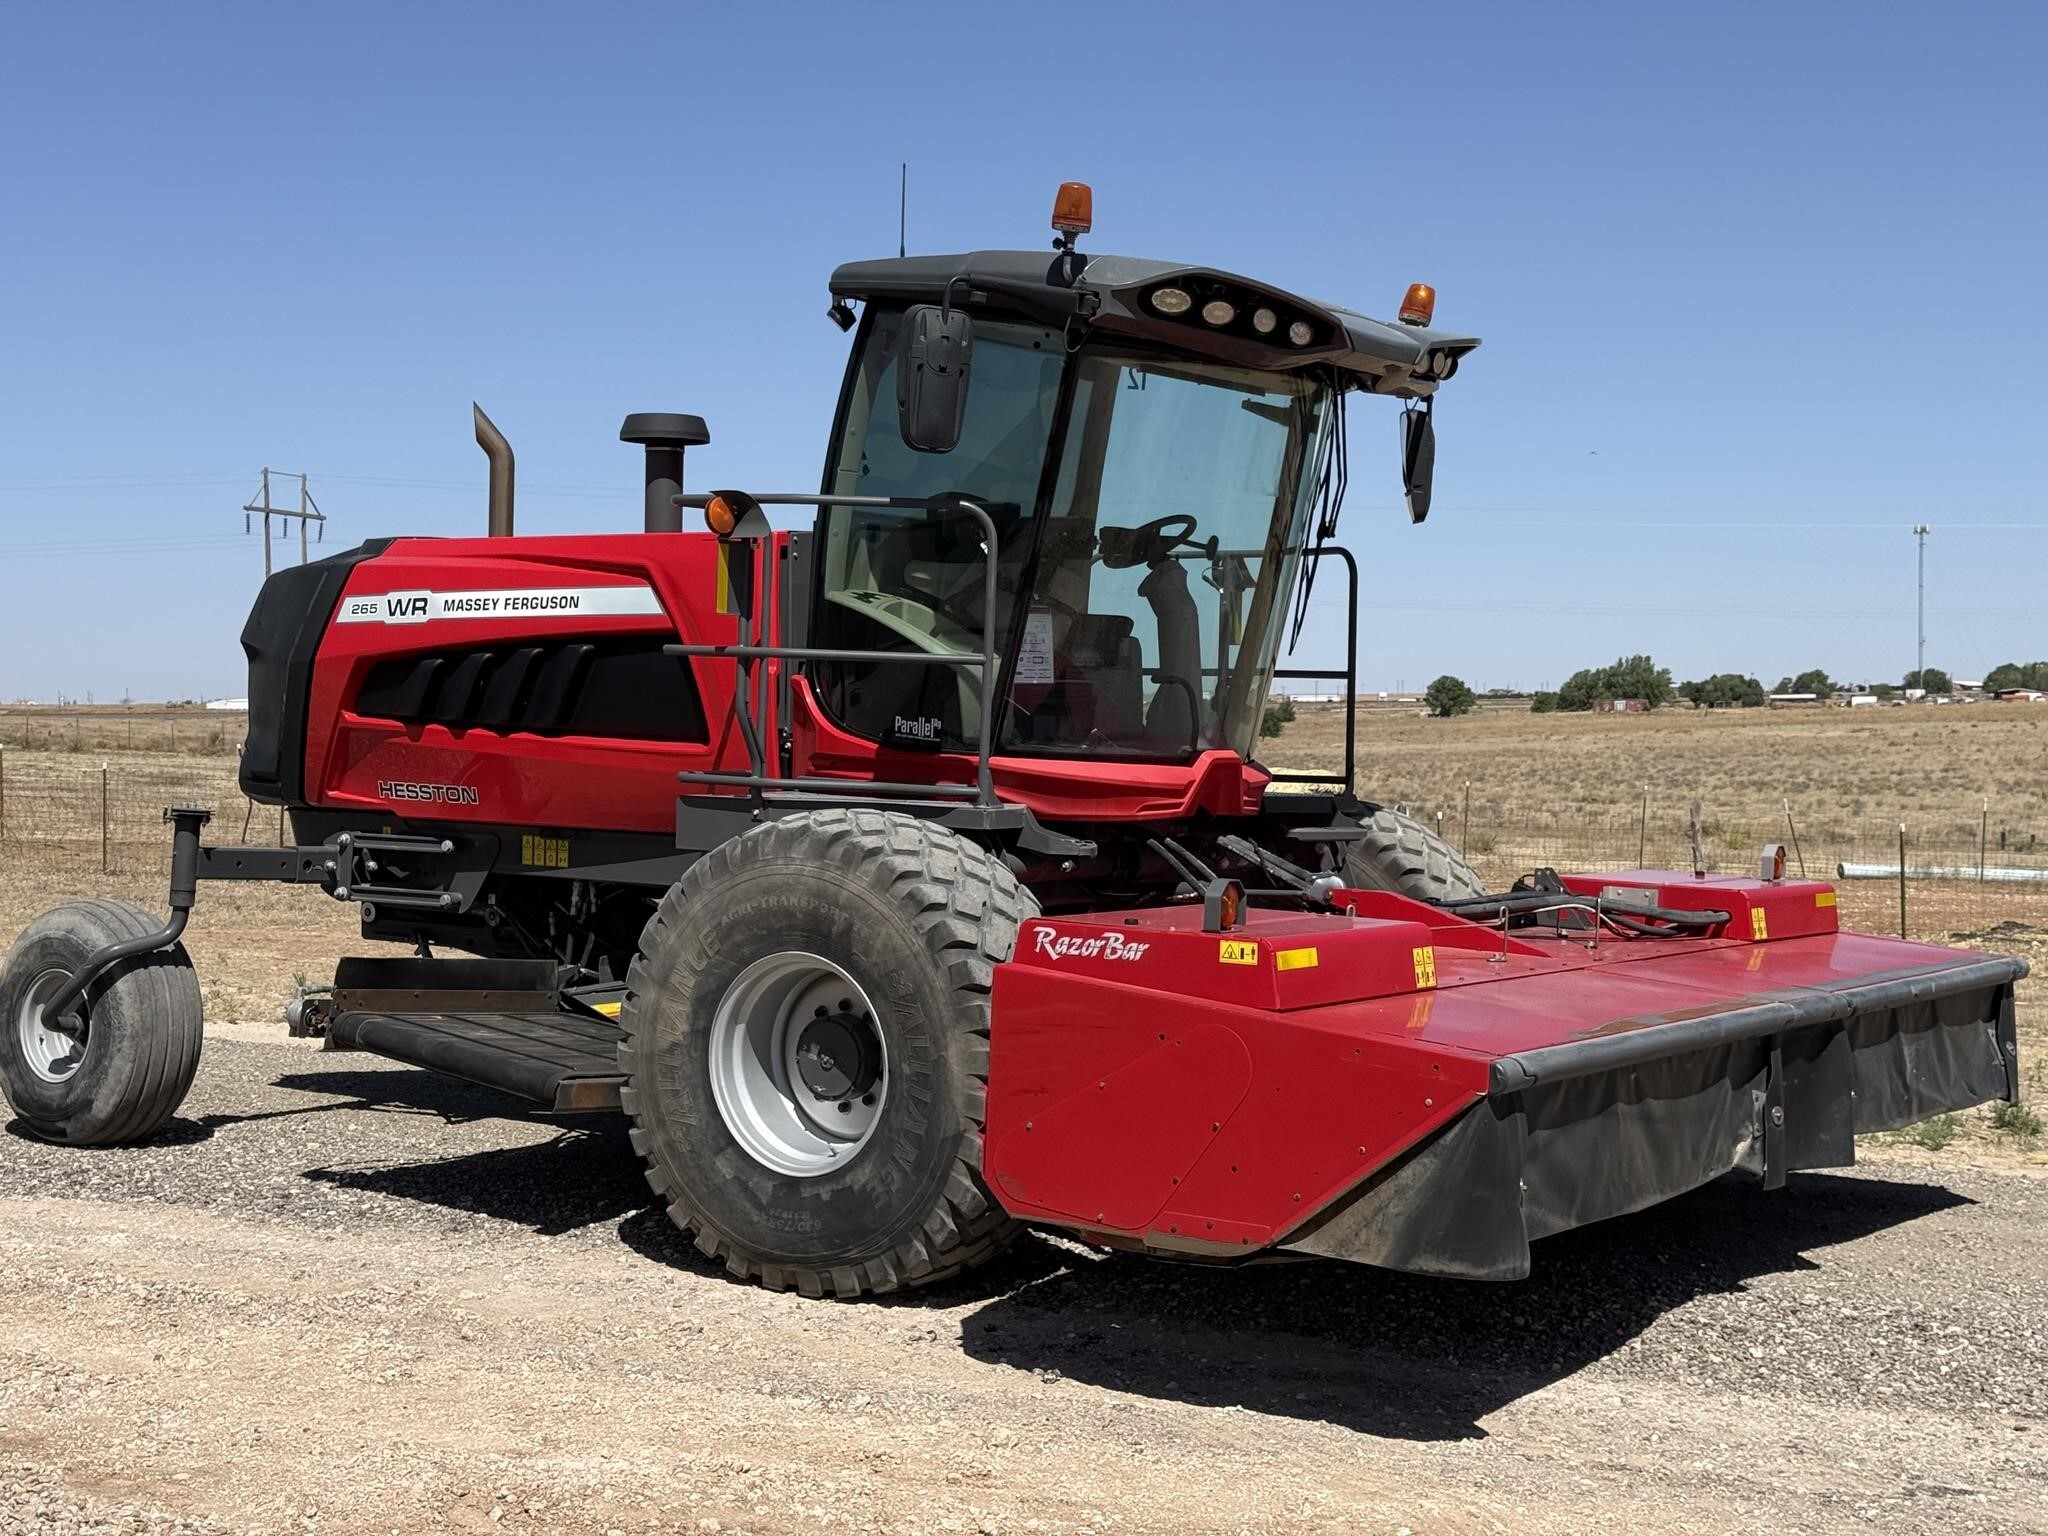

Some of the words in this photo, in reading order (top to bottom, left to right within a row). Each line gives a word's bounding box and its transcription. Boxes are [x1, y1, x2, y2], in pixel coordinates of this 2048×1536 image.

[351, 603, 378, 615] 265
[387, 597, 428, 617] WR
[443, 598, 500, 612] MASSEY
[503, 595, 580, 611] FERGUSON
[378, 780, 479, 805] HESSTON
[655, 927, 722, 1126] ALLIANCE
